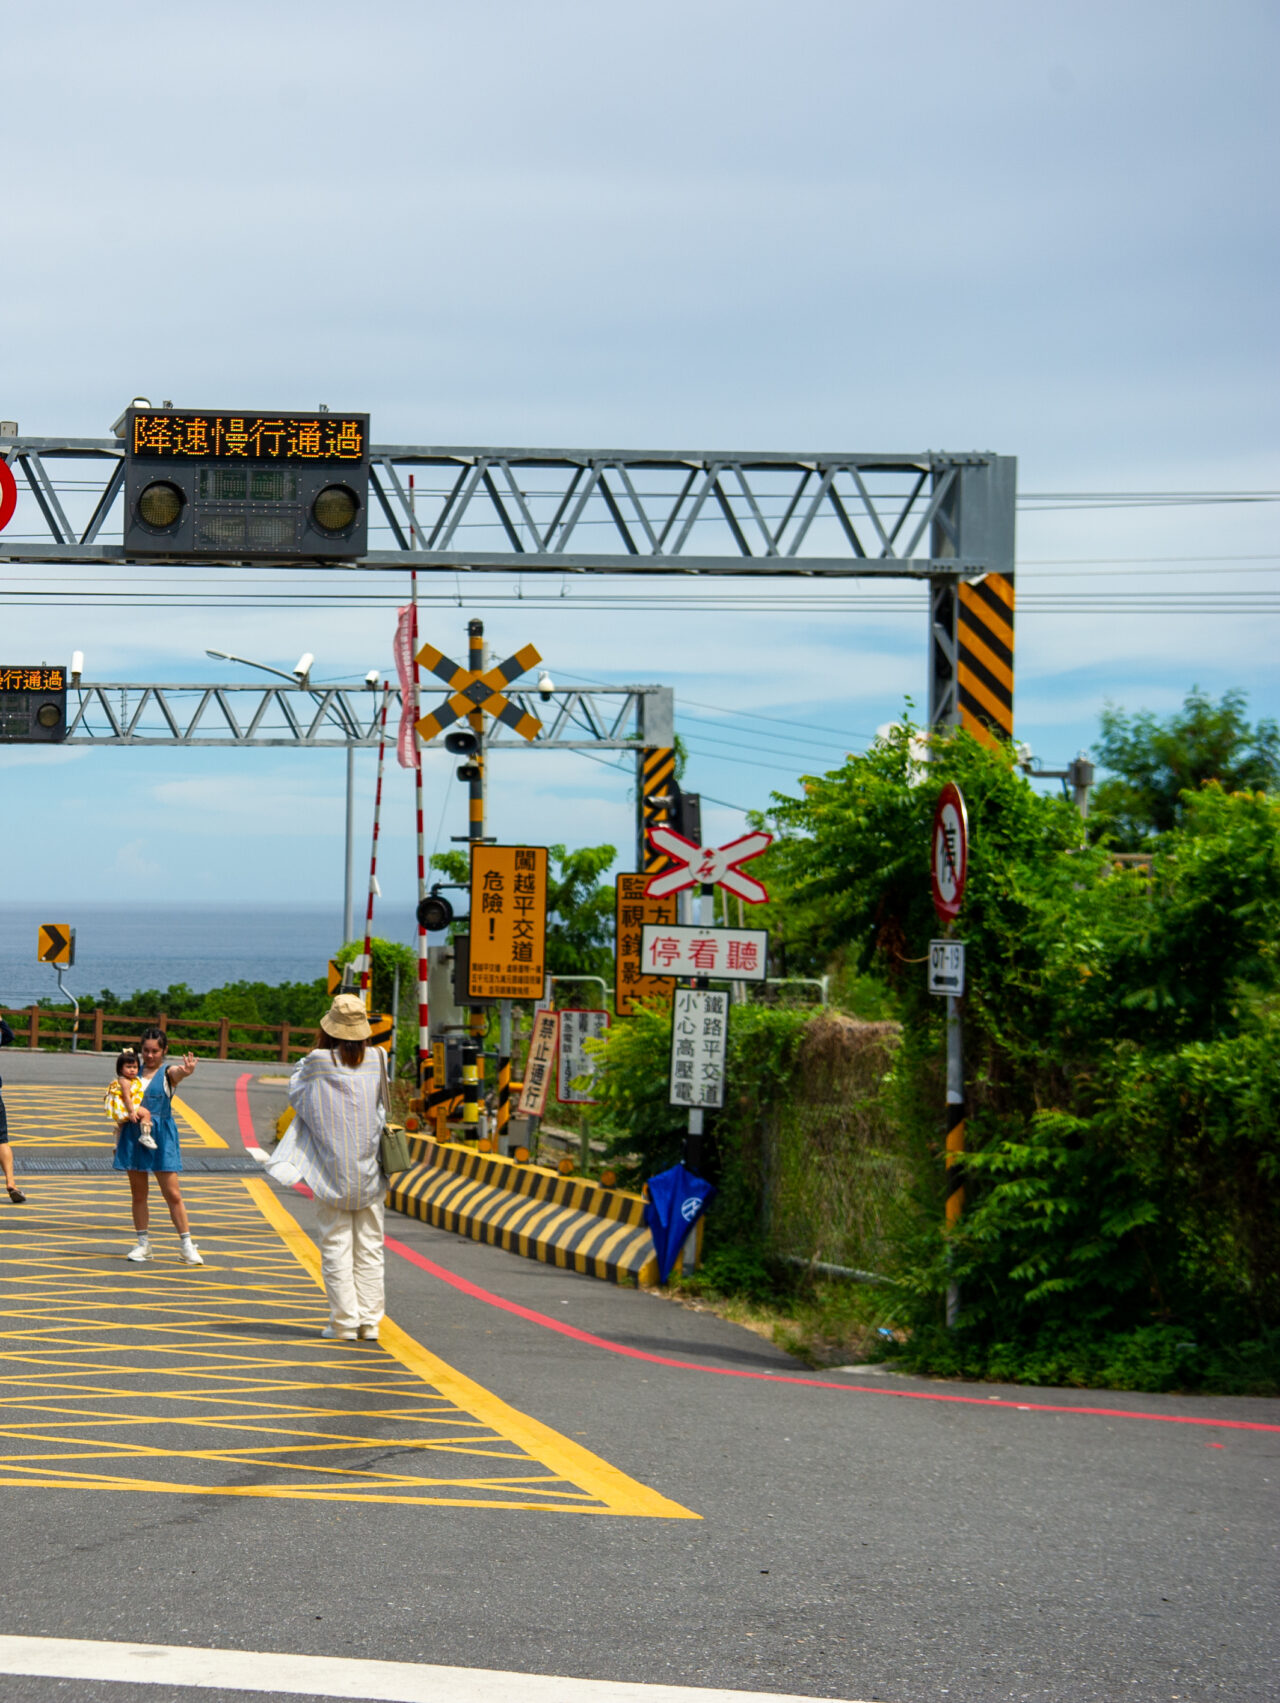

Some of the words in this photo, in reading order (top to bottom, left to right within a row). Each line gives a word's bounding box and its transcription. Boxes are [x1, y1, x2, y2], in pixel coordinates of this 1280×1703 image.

[134, 416, 363, 459] 降速慢行通過
[481, 868, 505, 942] 危險！
[511, 849, 537, 962] 闖越平交道
[649, 936, 758, 972] 停看聽
[932, 946, 960, 969] 07-19
[524, 1016, 556, 1109] 禁止通行
[672, 993, 697, 1103] 小心高壓電
[699, 995, 724, 1105] 鐵路平交道
